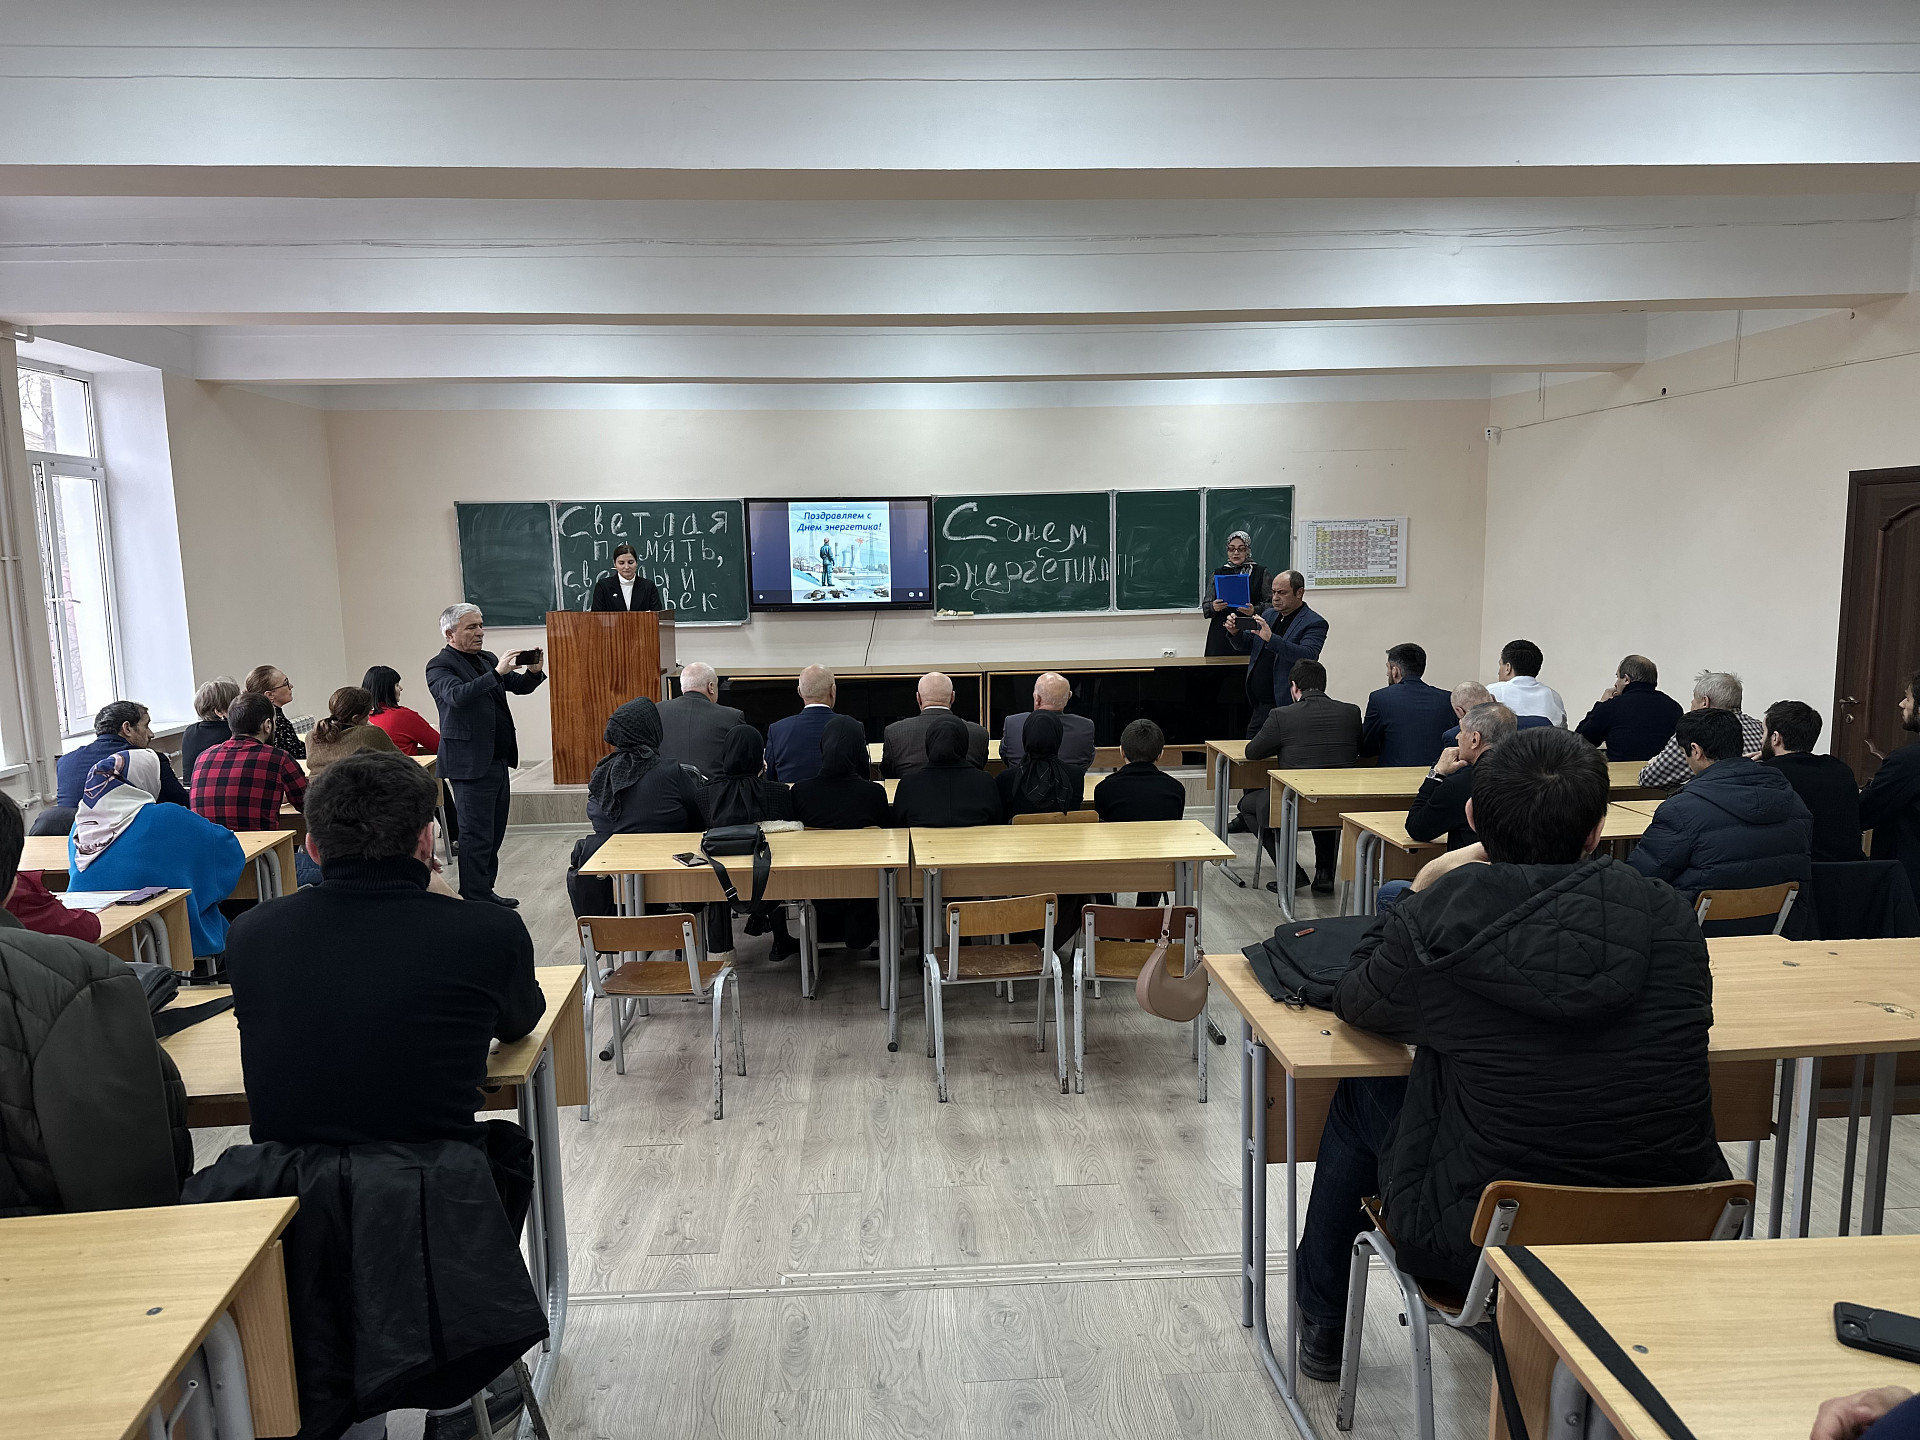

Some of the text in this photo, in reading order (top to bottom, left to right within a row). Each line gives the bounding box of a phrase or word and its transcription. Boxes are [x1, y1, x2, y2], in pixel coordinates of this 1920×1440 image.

[557, 504, 728, 538] Светлая
[796, 522, 882, 533] Днем энергетика!
[803, 511, 865, 522] Поздравляем
[942, 501, 998, 543] С
[594, 539, 724, 568] пмять,
[577, 587, 719, 612] чвек
